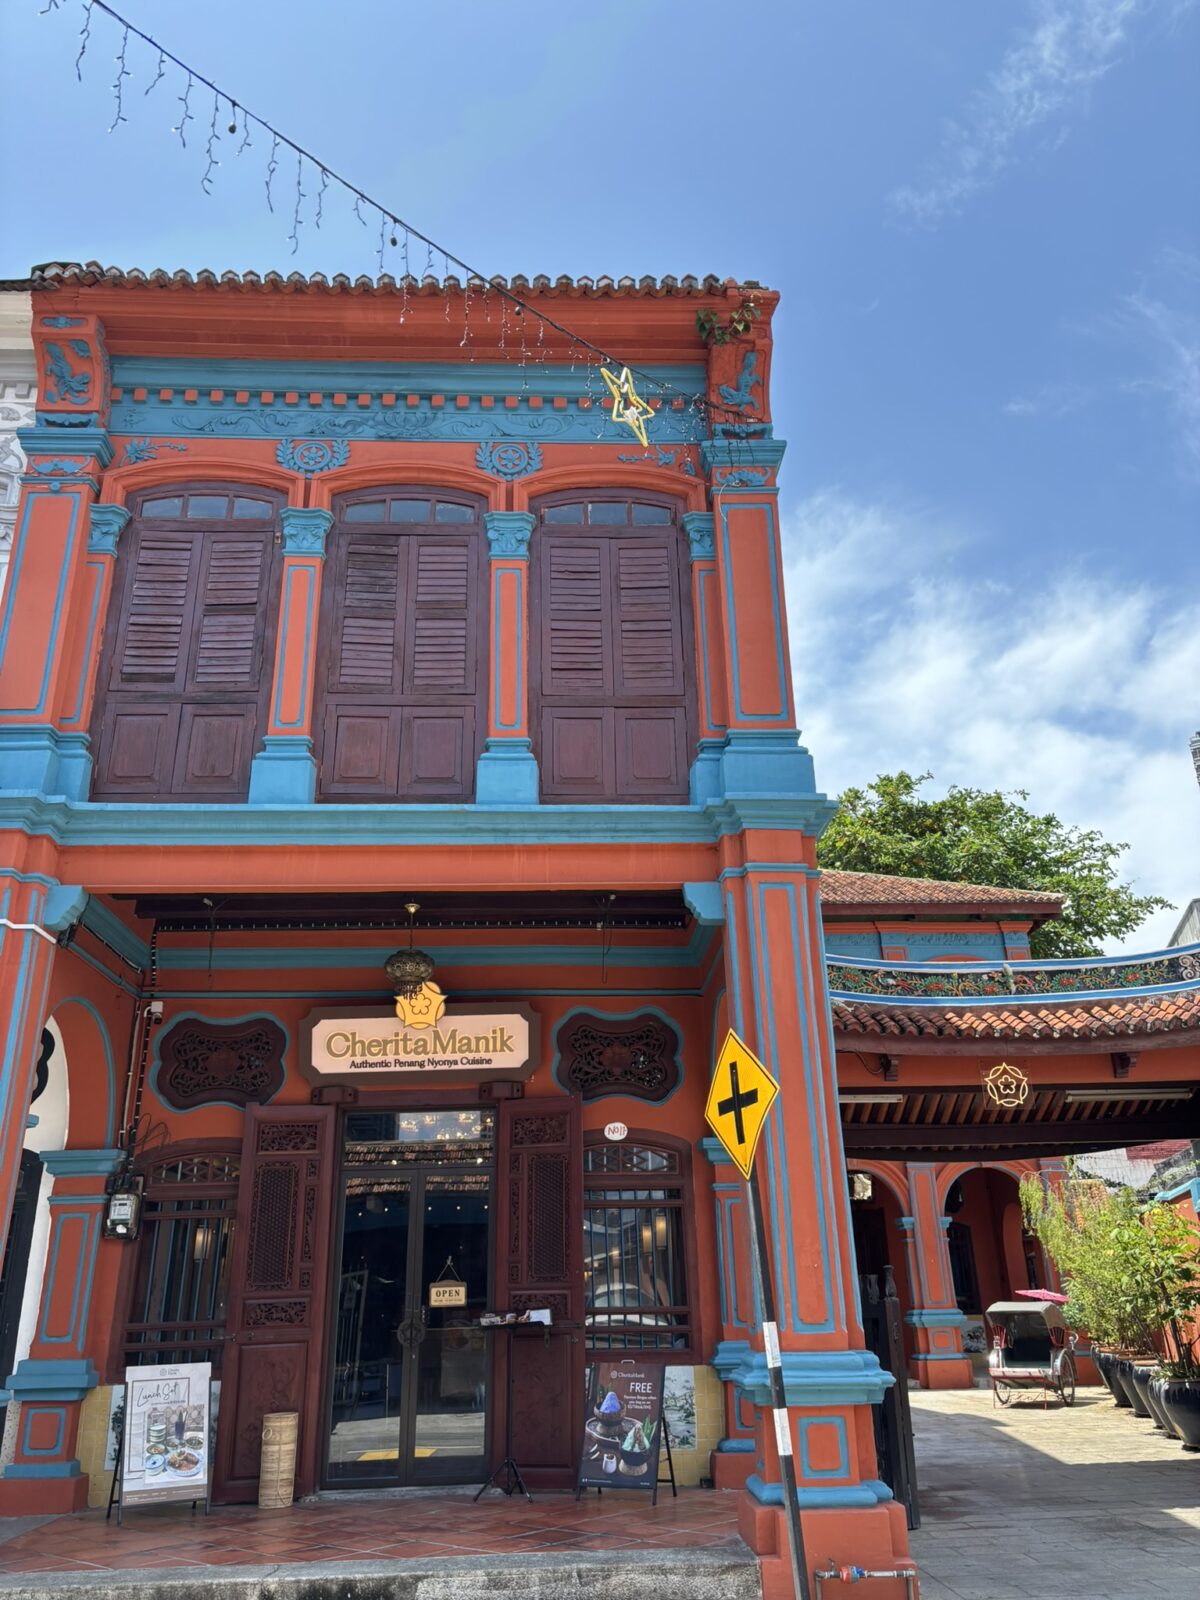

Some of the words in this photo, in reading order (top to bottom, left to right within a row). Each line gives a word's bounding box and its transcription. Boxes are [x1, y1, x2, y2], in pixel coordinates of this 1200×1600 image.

[349, 1060, 392, 1070] Authentic
[394, 1058, 426, 1069] Penang
[427, 1058, 459, 1068] Nyonya
[460, 1056, 493, 1066] Cuisine
[435, 1289, 460, 1297] OPEN
[629, 1382, 653, 1393] FREE
[137, 1384, 162, 1408] Lunch
[162, 1381, 180, 1401] Set
